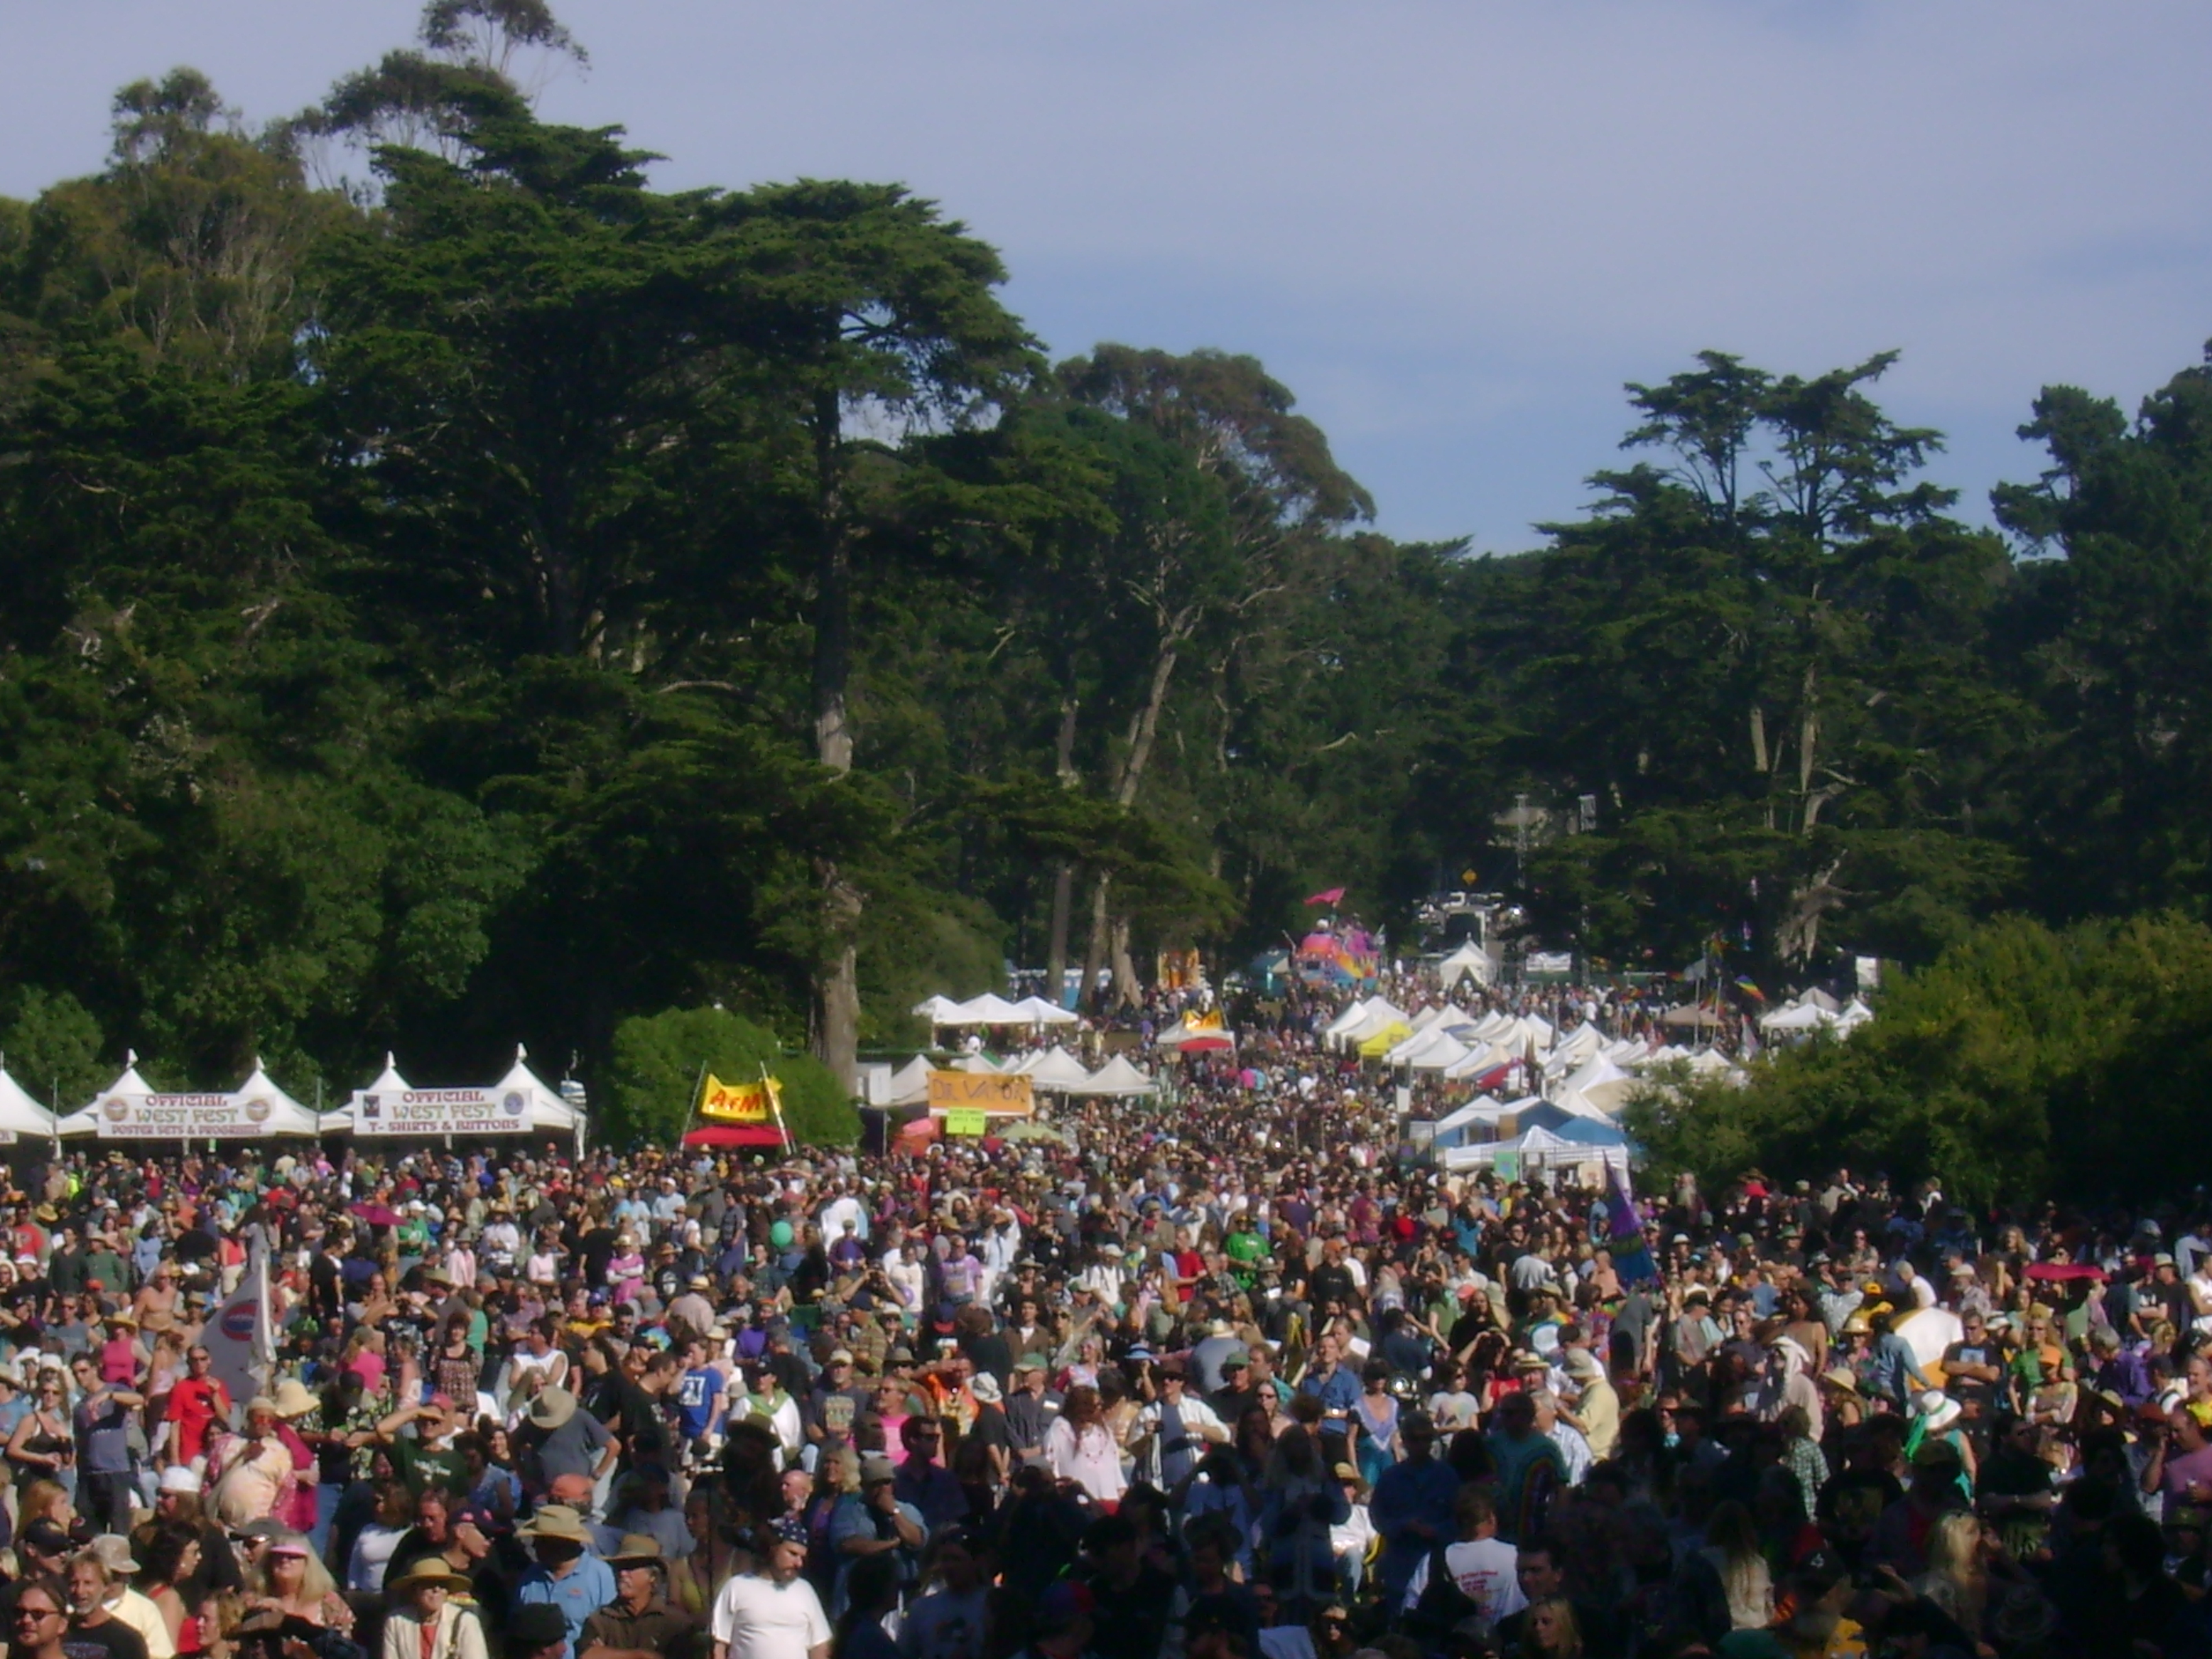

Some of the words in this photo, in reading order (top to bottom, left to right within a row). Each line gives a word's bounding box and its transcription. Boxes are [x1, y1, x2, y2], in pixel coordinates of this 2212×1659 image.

[145, 1094, 228, 1107] OFFICIAL
[402, 1090, 485, 1103] OFFICIAL
[135, 1108, 188, 1123] WEST
[192, 1108, 239, 1123] FEST
[392, 1104, 445, 1120] WEST
[450, 1104, 496, 1119] FEST
[388, 1120, 438, 1132] SHIRTS
[441, 1120, 452, 1131] &
[456, 1119, 519, 1131] BUTTONS
